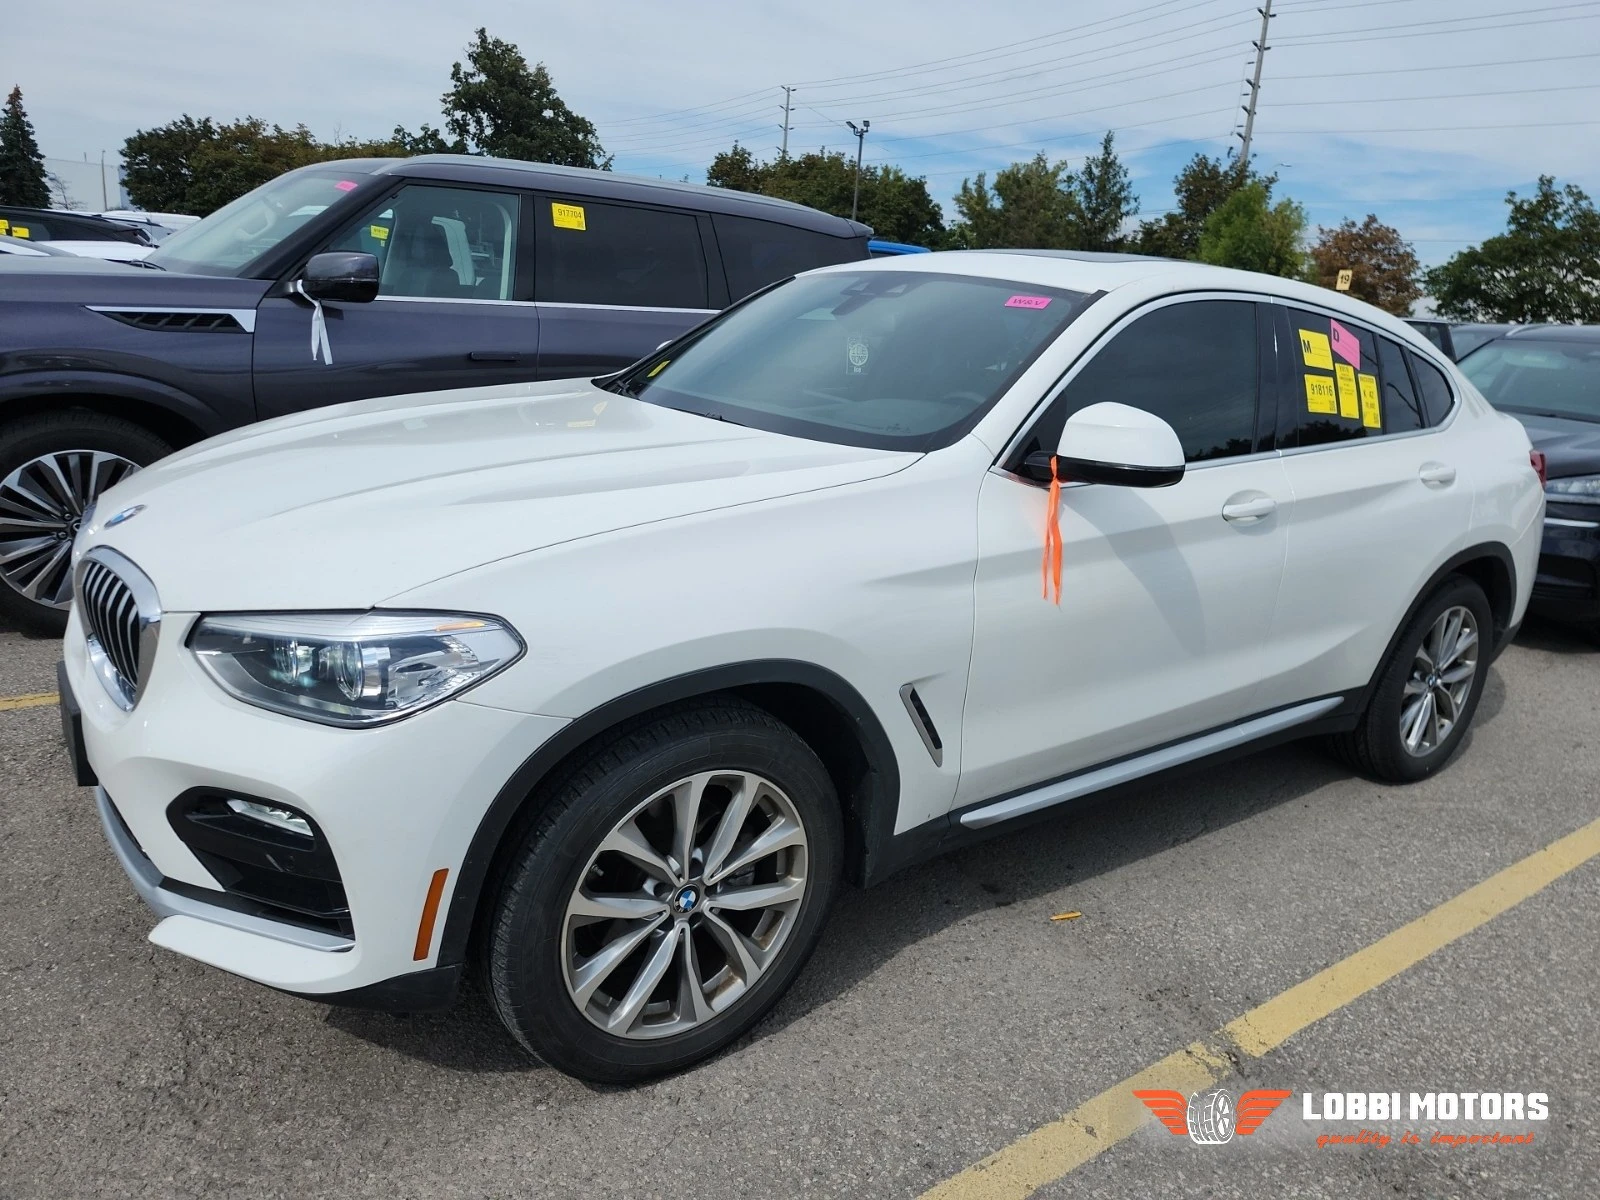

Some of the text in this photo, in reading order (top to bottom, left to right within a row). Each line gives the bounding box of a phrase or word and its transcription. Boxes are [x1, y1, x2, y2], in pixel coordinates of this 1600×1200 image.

[557, 208, 582, 219] 917704
[1340, 274, 1350, 285] 19
[1332, 327, 1340, 343] D
[1302, 339, 1312, 354] M
[1310, 383, 1334, 397] 918116
